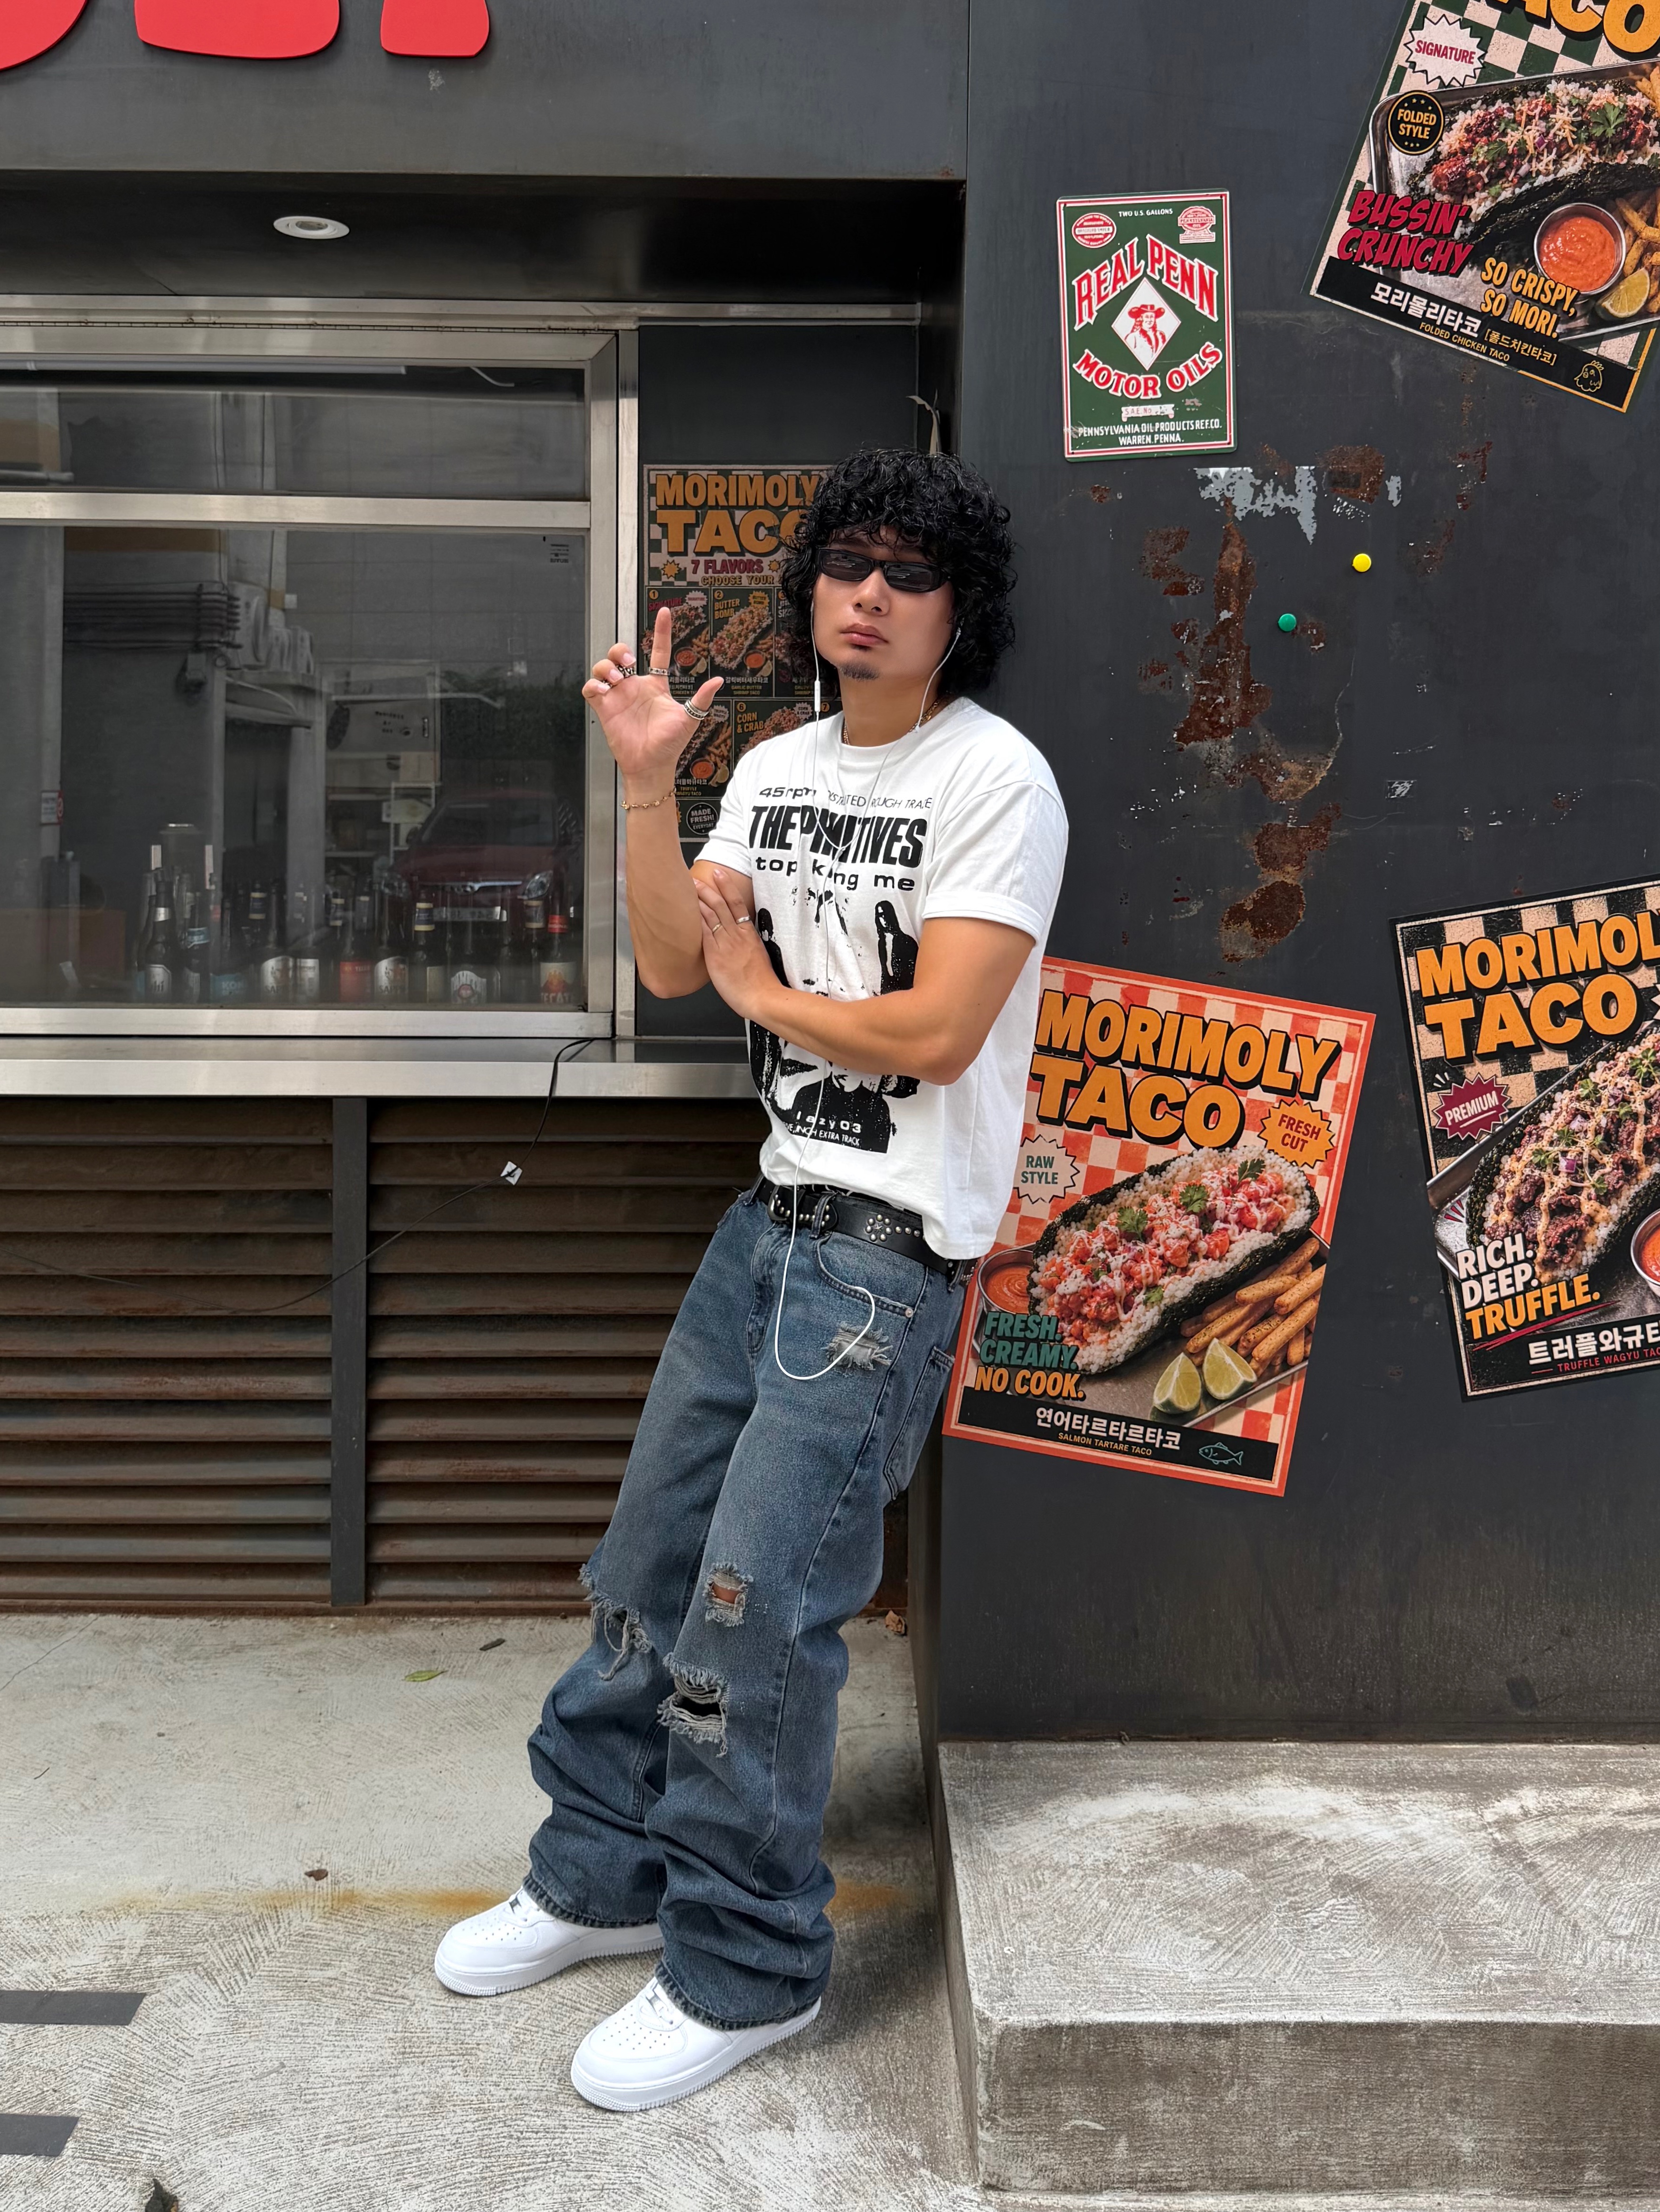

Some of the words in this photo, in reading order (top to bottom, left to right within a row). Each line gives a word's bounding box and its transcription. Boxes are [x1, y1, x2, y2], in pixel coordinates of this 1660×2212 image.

[1414, 40, 1476, 65] SIGNATURE
[1398, 110, 1436, 125] FOLDED
[1399, 123, 1430, 139] STYLE
[1348, 190, 1469, 235] BUSSIN'
[1337, 228, 1474, 274] CRUNCHY
[1072, 237, 1145, 331] REAL
[1147, 234, 1218, 322] PENN
[1481, 257, 1508, 285] SO
[1511, 269, 1579, 317] CRISPY,
[1370, 281, 1482, 338] 모리몰리타코
[1484, 328, 1557, 366] [폴드치킨타코]
[1480, 288, 1507, 317] SO
[1509, 299, 1558, 338] MORI.
[1419, 322, 1450, 339] FOLDED
[1452, 334, 1487, 353] CHICKEN
[1489, 348, 1510, 362] TACO
[1073, 349, 1161, 399] MOTOR
[1166, 342, 1222, 391] OILS
[1078, 424, 1140, 437] PENNSYLVANIA
[1141, 423, 1154, 433] OIL
[1155, 420, 1194, 432] PRODUCTS
[656, 474, 820, 507] MORIMOLY
[691, 559, 700, 574] 7
[704, 558, 764, 574] FLAVORS
[701, 576, 742, 586] CHOOSE
[746, 575, 774, 585] YOUR
[714, 598, 740, 610] BUTTER
[714, 609, 735, 619] BOMB
[737, 712, 757, 724] CORN
[737, 724, 743, 733] &
[744, 721, 764, 732] CRAB
[691, 809, 711, 817] MADE
[905, 797, 933, 809] TRAE
[873, 874, 915, 892] me
[1416, 909, 1660, 997] MORIMOL
[1424, 973, 1637, 1060] TACO
[1036, 990, 1340, 1095] MORIMOLY
[1032, 1055, 1240, 1148] TACO
[1444, 1090, 1499, 1126] PREMIUM
[819, 1130, 839, 1141] EXTRA
[842, 1134, 860, 1146] TRACK
[1277, 1113, 1321, 1141] FRESH
[1281, 1133, 1308, 1152] CUT
[1026, 1154, 1054, 1169] RAW
[1021, 1170, 1058, 1185] STYLE
[1456, 1234, 1534, 1280] RICH.
[1461, 1263, 1539, 1309] DEEP.
[1465, 1273, 1601, 1340] TRUFFLE.
[984, 1311, 1062, 1341] FRESH.
[980, 1339, 1079, 1370] CREAMY.
[1557, 1357, 1600, 1372] TRUFFLE
[1604, 1350, 1640, 1365] WAGYU
[974, 1366, 1009, 1393] NO
[1015, 1369, 1084, 1398] COOK.
[1036, 1407, 1181, 1450] 연어타르타르타코
[1058, 1432, 1092, 1445] SALMON
[1094, 1439, 1129, 1452] TARTARE
[1131, 1446, 1152, 1456] TACO
